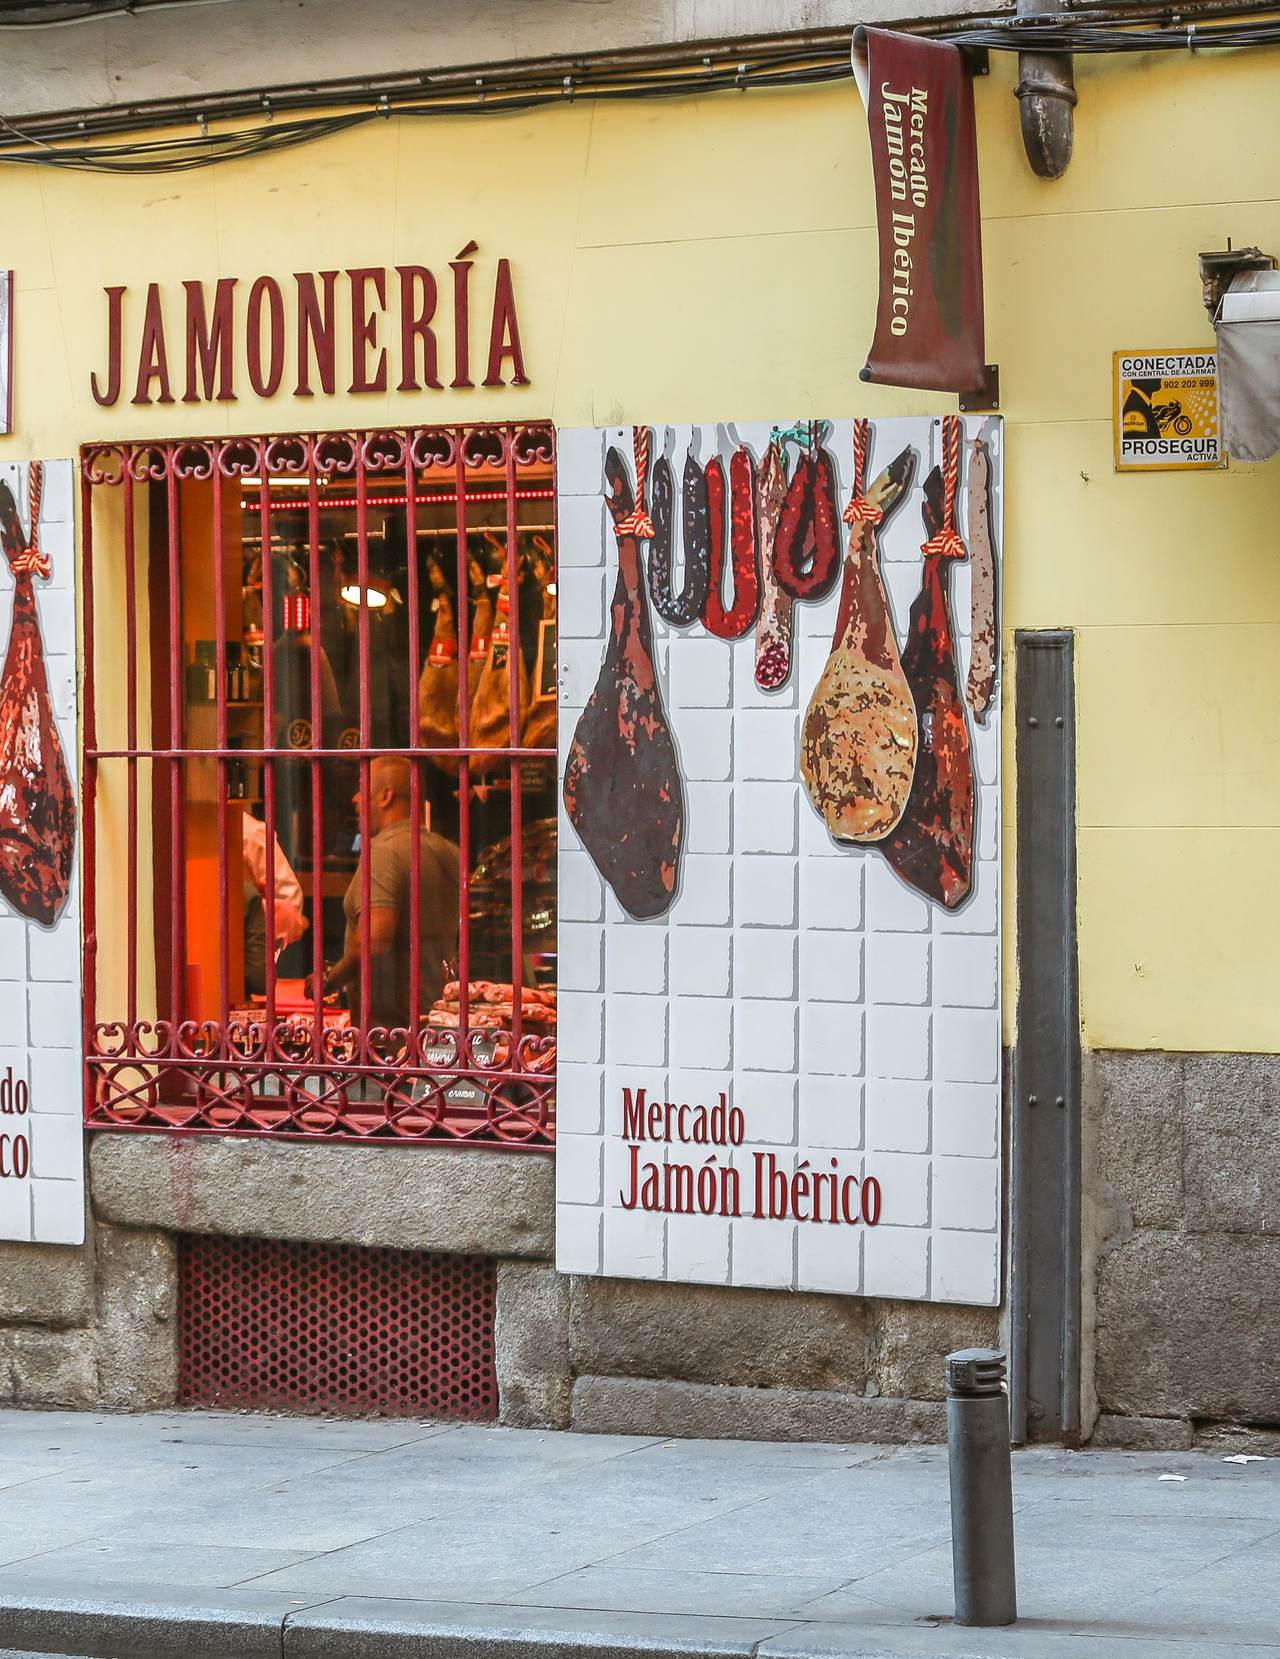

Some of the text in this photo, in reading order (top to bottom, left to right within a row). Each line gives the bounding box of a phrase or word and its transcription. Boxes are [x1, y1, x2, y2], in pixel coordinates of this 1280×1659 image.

[910, 87, 929, 208] Mercado
[881, 82, 915, 336] Jamón Ibérico
[90, 240, 531, 406] JAMONERÍA
[1122, 356, 1216, 371] CONECTADA
[1181, 380, 1197, 388] 202
[1200, 379, 1215, 388] 999
[1122, 439, 1218, 455] PROSEGUR
[1187, 453, 1218, 461] ACTIVA
[621, 1087, 745, 1146] Mercado
[620, 1144, 881, 1226] Jamón Ibérico
